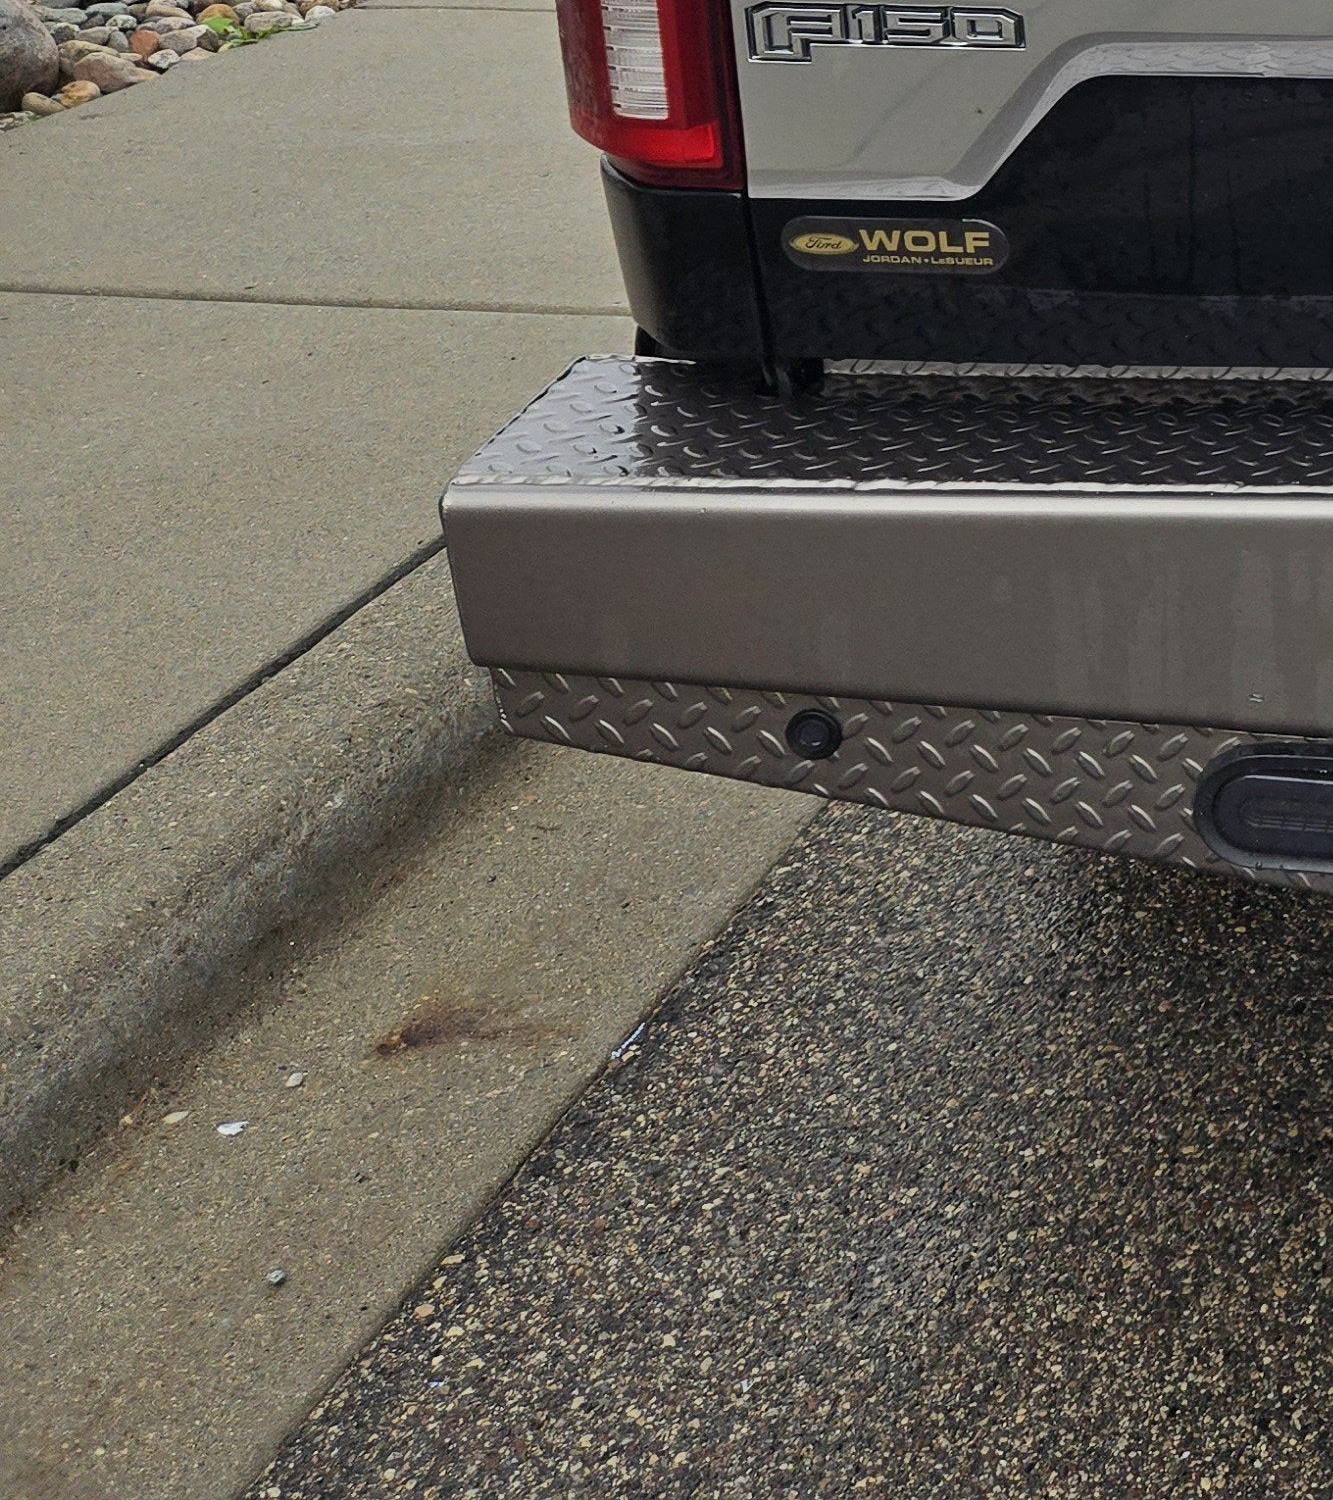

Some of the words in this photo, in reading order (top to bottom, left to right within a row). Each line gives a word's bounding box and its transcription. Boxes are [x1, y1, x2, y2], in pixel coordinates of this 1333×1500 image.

[804, 235, 842, 250] Ford
[858, 228, 990, 254] WOLF
[862, 254, 922, 264] JORDAN
